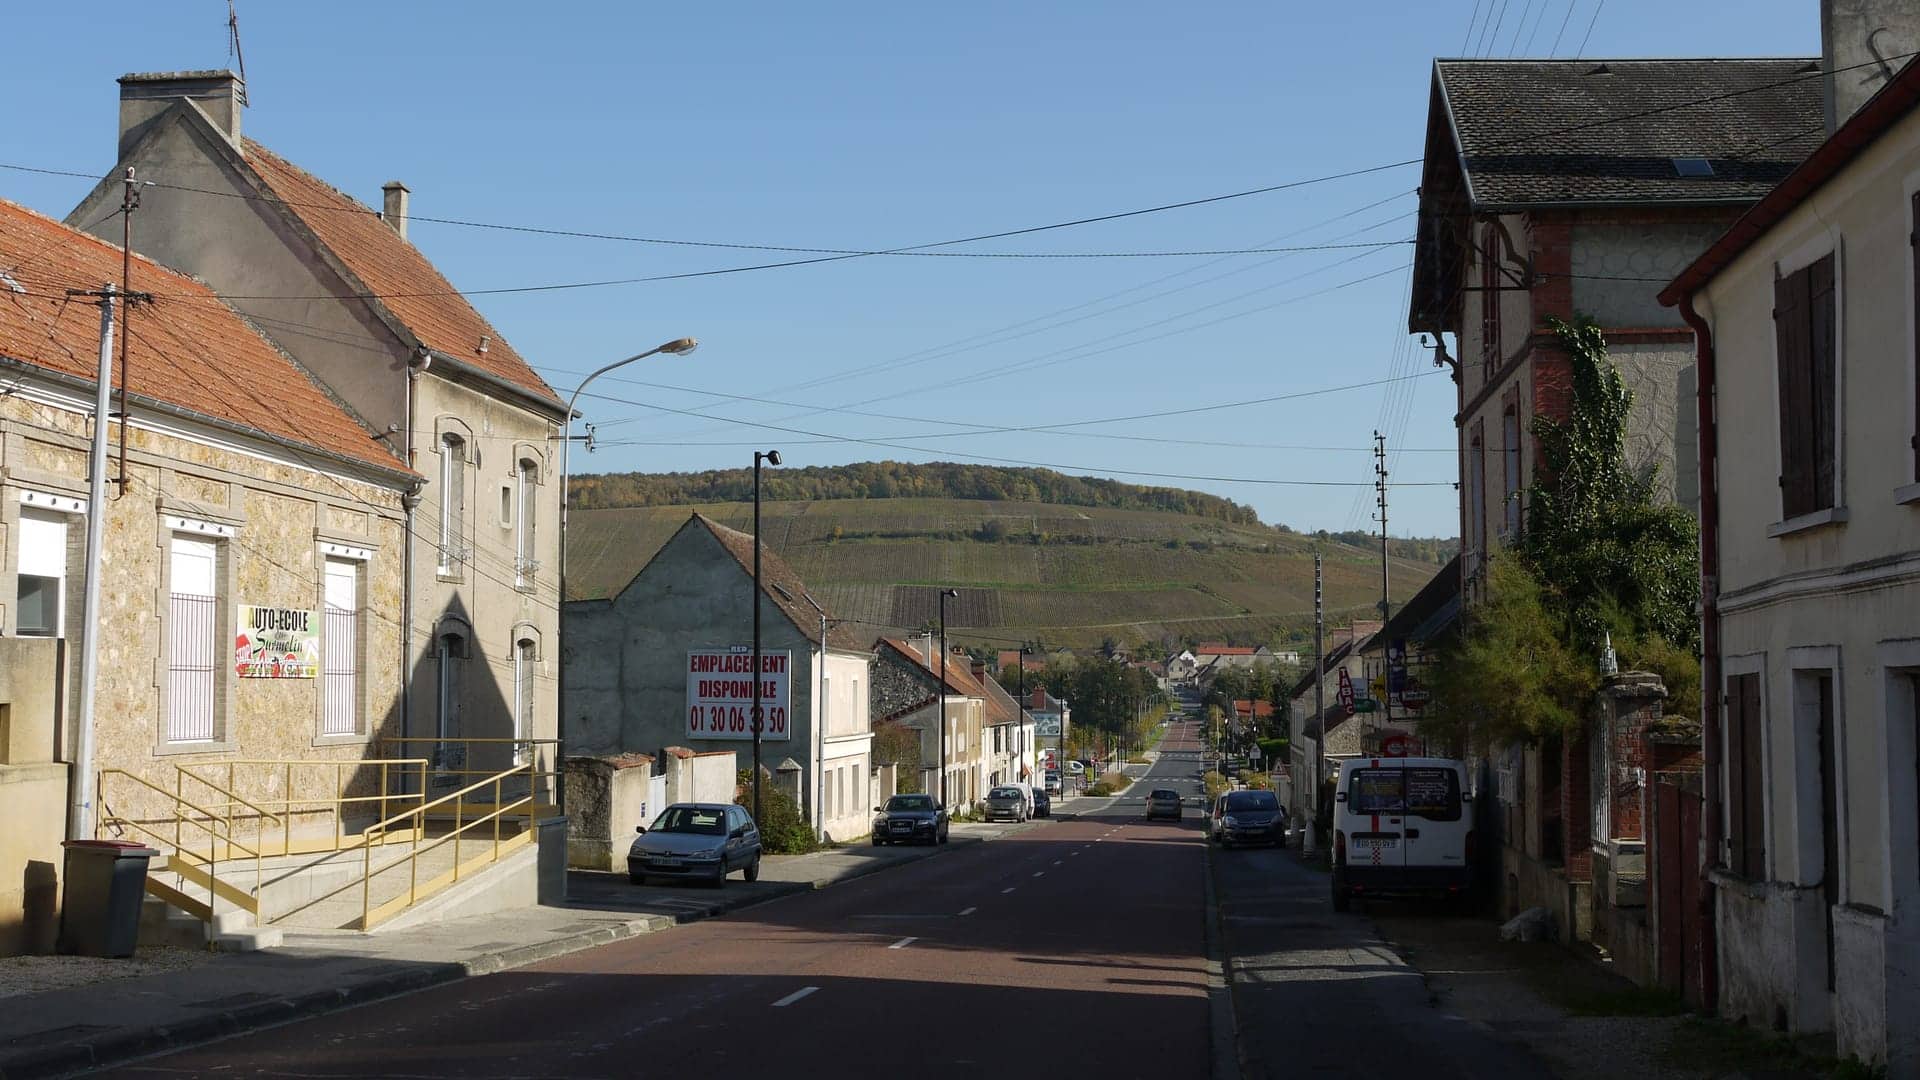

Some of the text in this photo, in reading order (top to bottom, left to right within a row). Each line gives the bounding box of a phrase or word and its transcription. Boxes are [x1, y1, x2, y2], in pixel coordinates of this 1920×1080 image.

[248, 607, 308, 632] AUTO-ECOLE
[253, 628, 303, 654] Surmelin
[1339, 668, 1354, 714] TABAC
[690, 705, 705, 731] 01
[710, 706, 725, 732] 30
[729, 706, 745, 732] 06
[769, 707, 785, 733] 50
